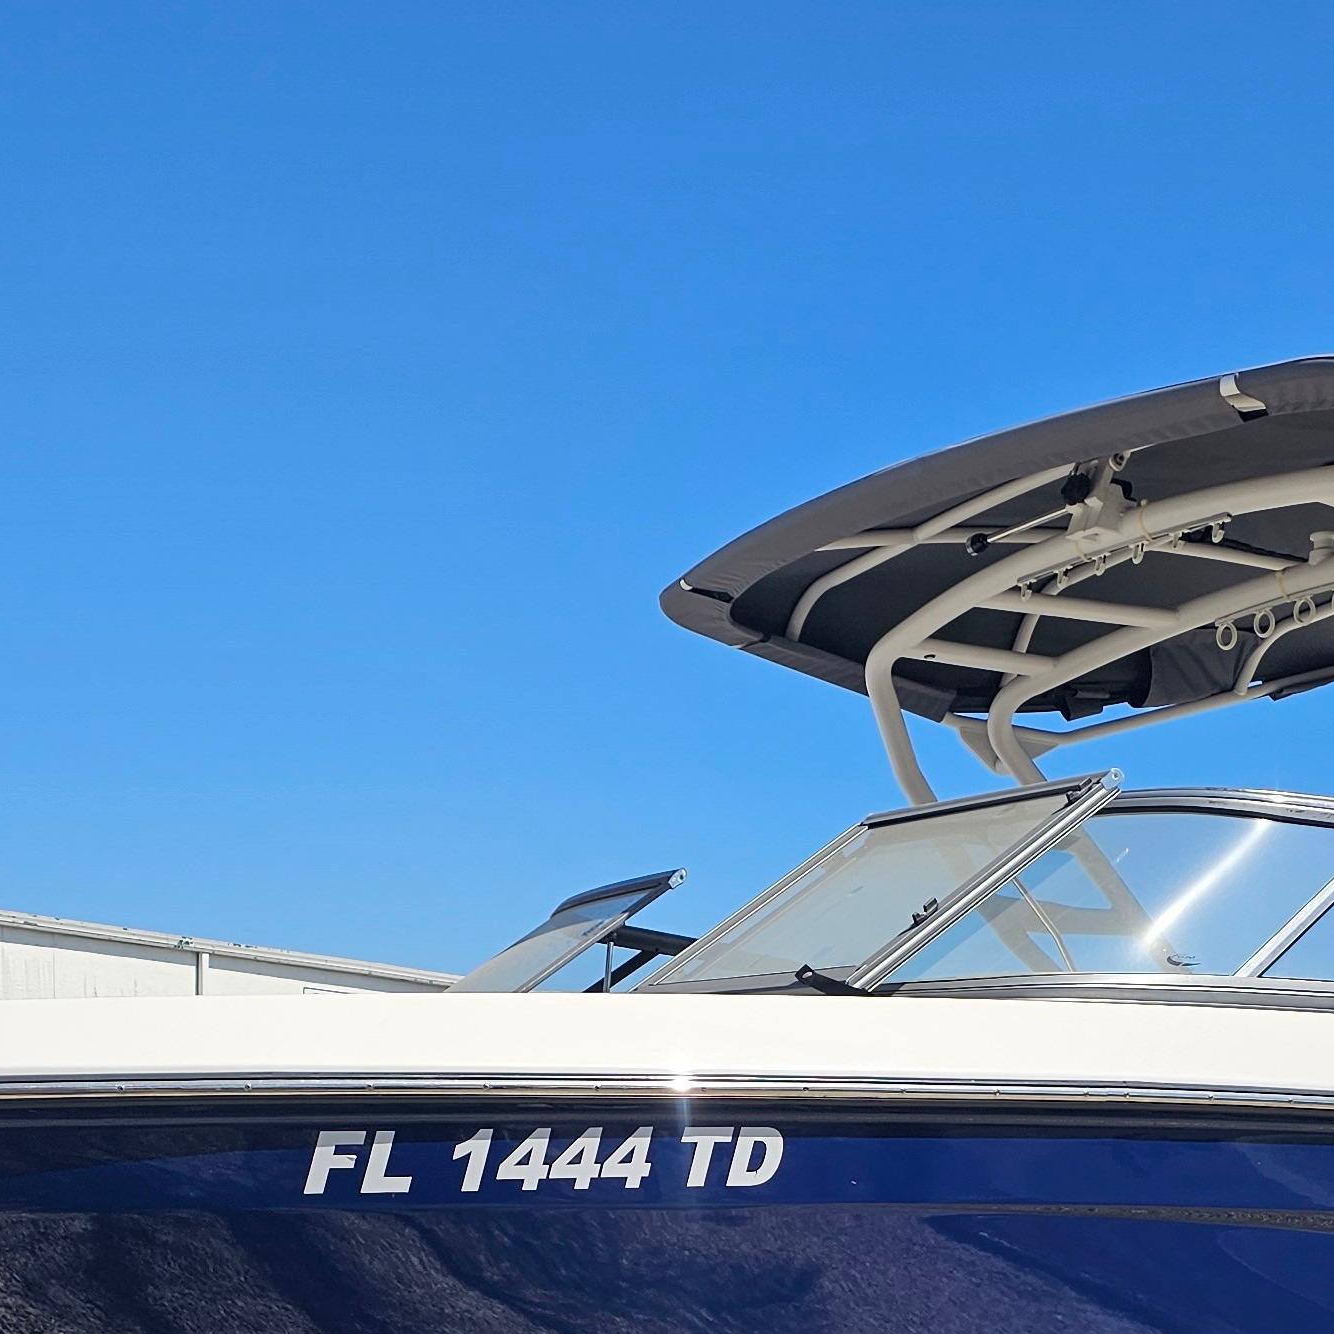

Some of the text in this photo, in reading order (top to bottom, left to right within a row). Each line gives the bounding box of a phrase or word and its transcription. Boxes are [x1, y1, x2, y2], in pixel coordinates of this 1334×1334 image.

[303, 1125, 785, 1195] FL 1444 TD
